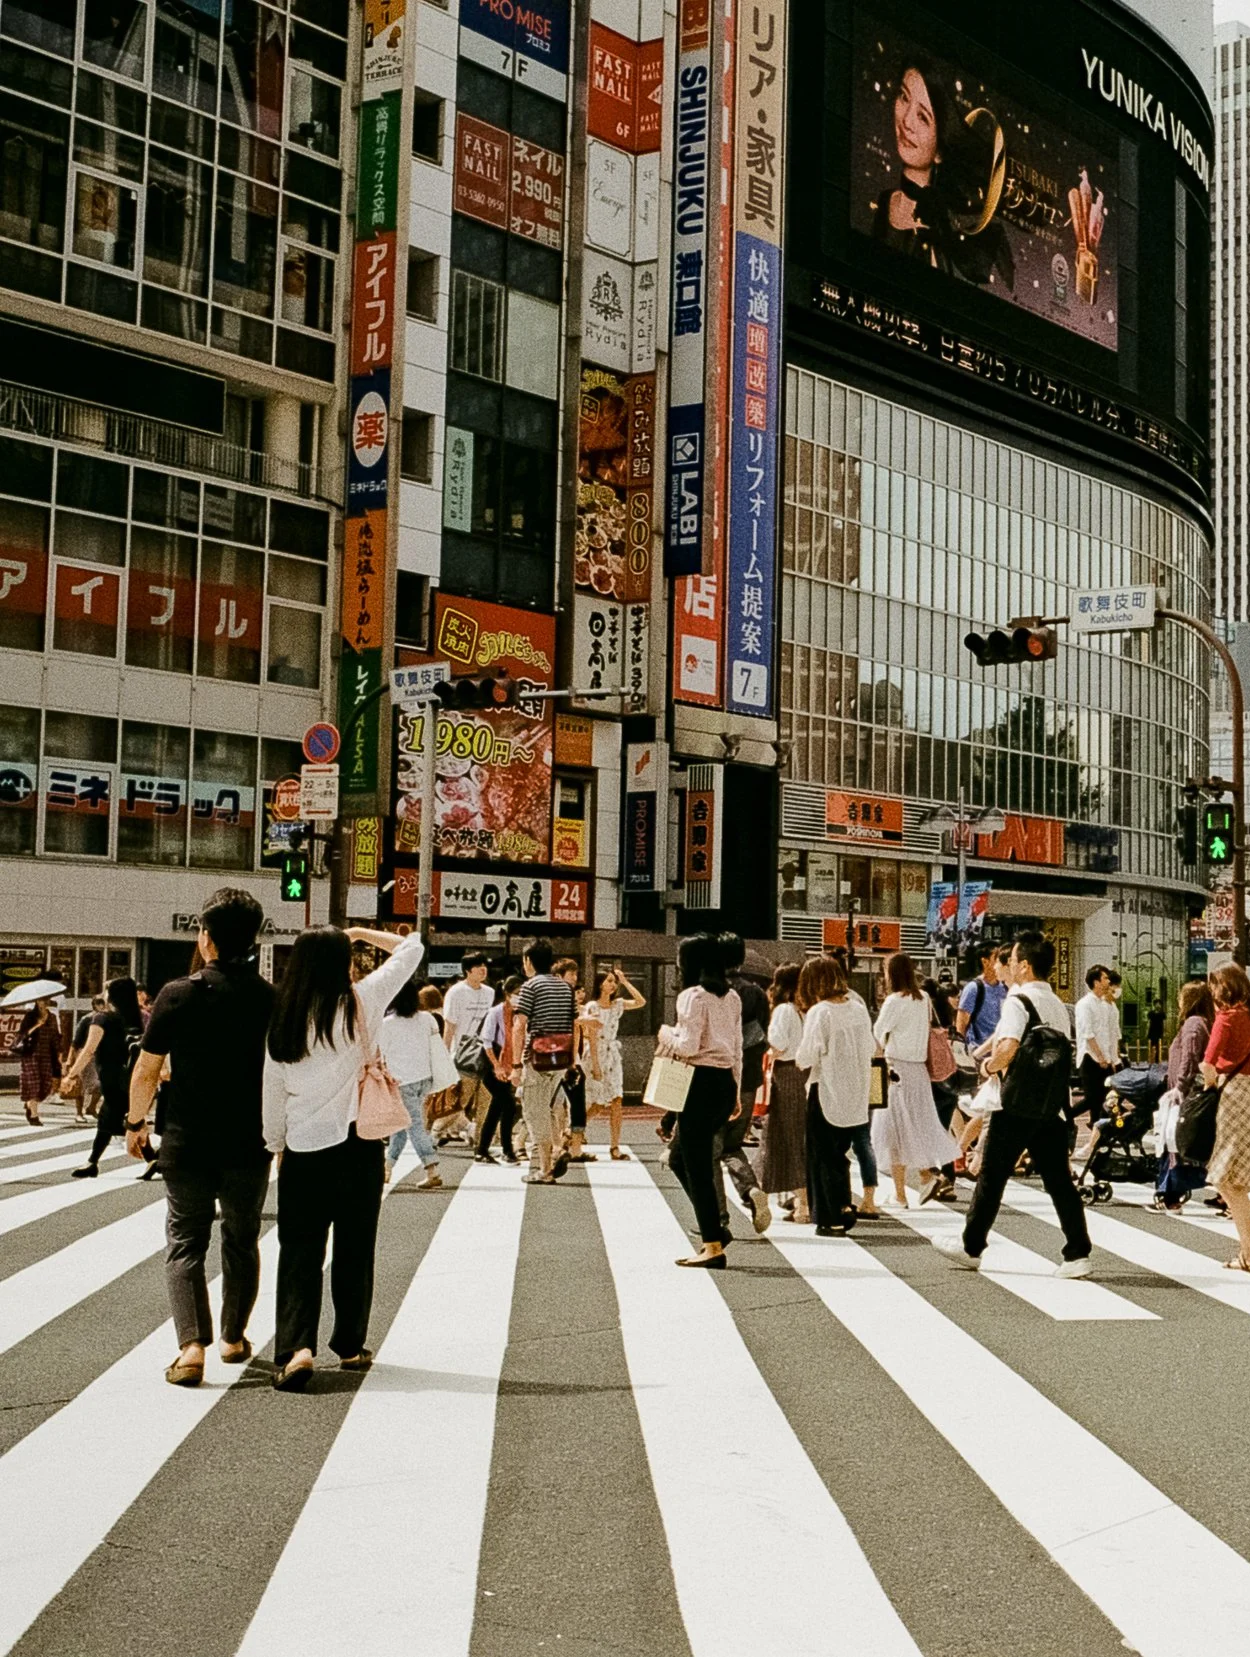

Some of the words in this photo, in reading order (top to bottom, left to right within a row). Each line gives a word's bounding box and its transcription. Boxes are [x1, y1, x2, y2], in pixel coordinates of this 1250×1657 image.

[526, 33, 550, 51] プロミス
[595, 50, 632, 80] FAST
[594, 73, 632, 102] NAIL
[616, 122, 630, 138] 6F
[1081, 48, 1167, 140] YUNIKA
[1170, 112, 1210, 192] VISION
[464, 134, 501, 161] FAST
[513, 139, 562, 177] ネイル
[678, 64, 707, 236] SHINJUKU
[464, 154, 500, 181] NAIL
[1009, 157, 1059, 198] TSUBAKI
[362, 243, 389, 363] アイフル
[585, 327, 627, 350] Rydia
[355, 411, 386, 451] 薬
[680, 471, 699, 545] LABI
[0, 558, 248, 639] アイフル
[1078, 590, 1147, 613] 歌舞伎町
[1090, 612, 1134, 625] Kabukicho
[394, 667, 446, 688] 歌舞伎町
[50, 770, 241, 825] ミネドラッグ
[634, 800, 647, 868] PROMISE
[691, 798, 710, 874] 吉野家
[558, 883, 581, 906] 24
[936, 960, 956, 971] TAXI
